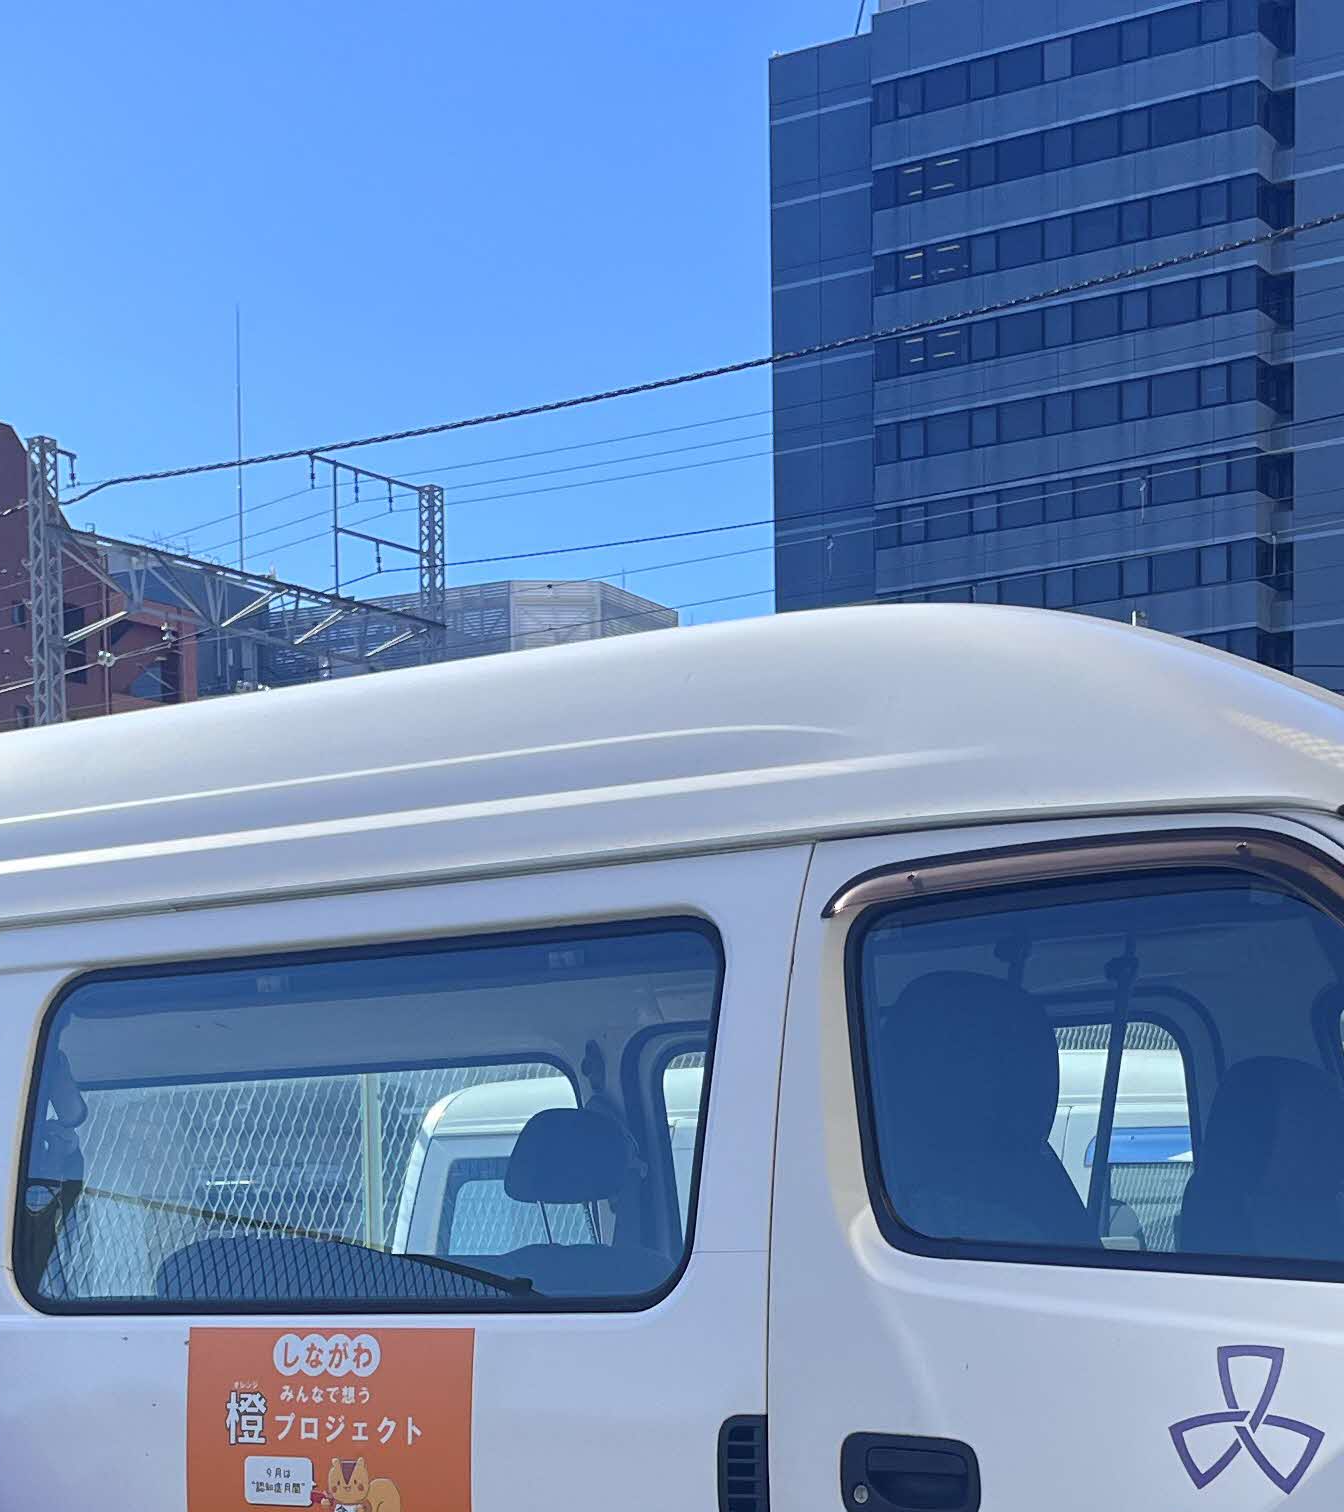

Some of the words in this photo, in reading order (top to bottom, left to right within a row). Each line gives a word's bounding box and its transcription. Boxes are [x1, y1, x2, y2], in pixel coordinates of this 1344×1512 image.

[283, 1341, 373, 1369] しながわ
[279, 1384, 370, 1404] みんなで想う
[274, 1411, 423, 1446] プロジェクト
